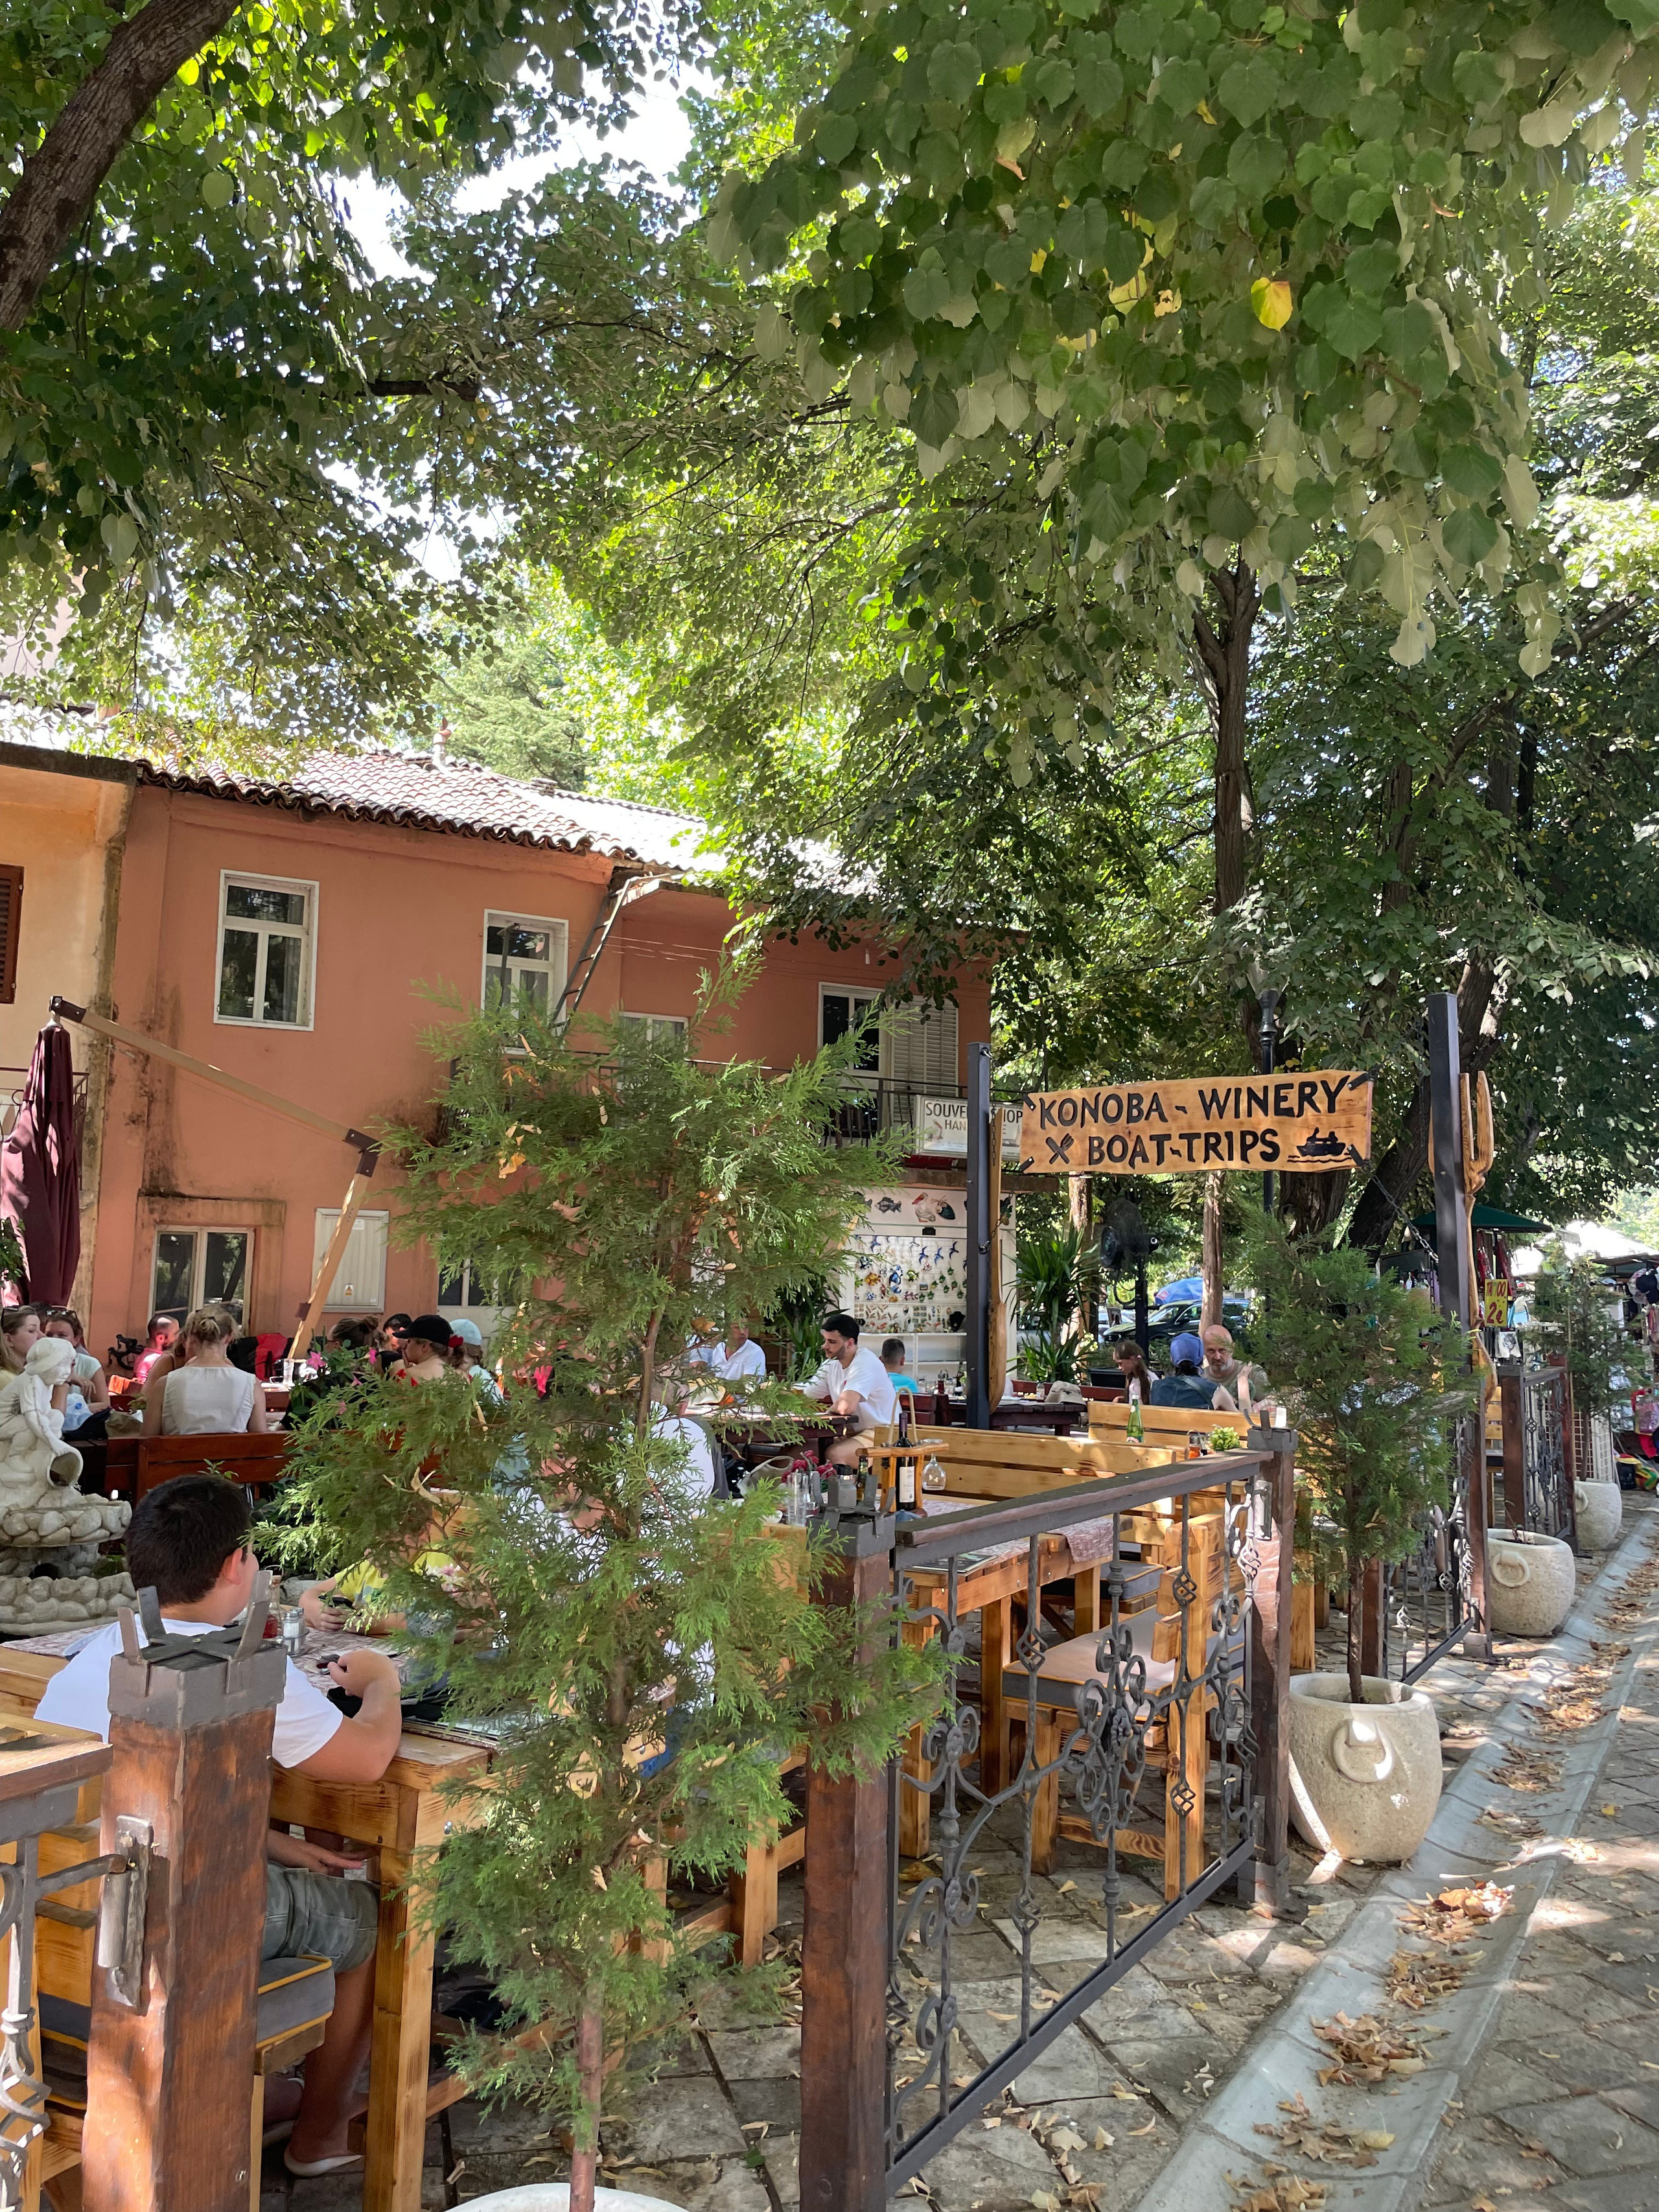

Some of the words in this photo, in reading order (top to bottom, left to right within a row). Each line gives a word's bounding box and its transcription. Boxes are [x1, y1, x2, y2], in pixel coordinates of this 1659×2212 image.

[925, 1102, 966, 1119] SOUVE
[1039, 1092, 1168, 1130] KONOBA
[1198, 1075, 1350, 1121] WINERY
[1089, 1128, 1280, 1169] BOAT-TRIPS
